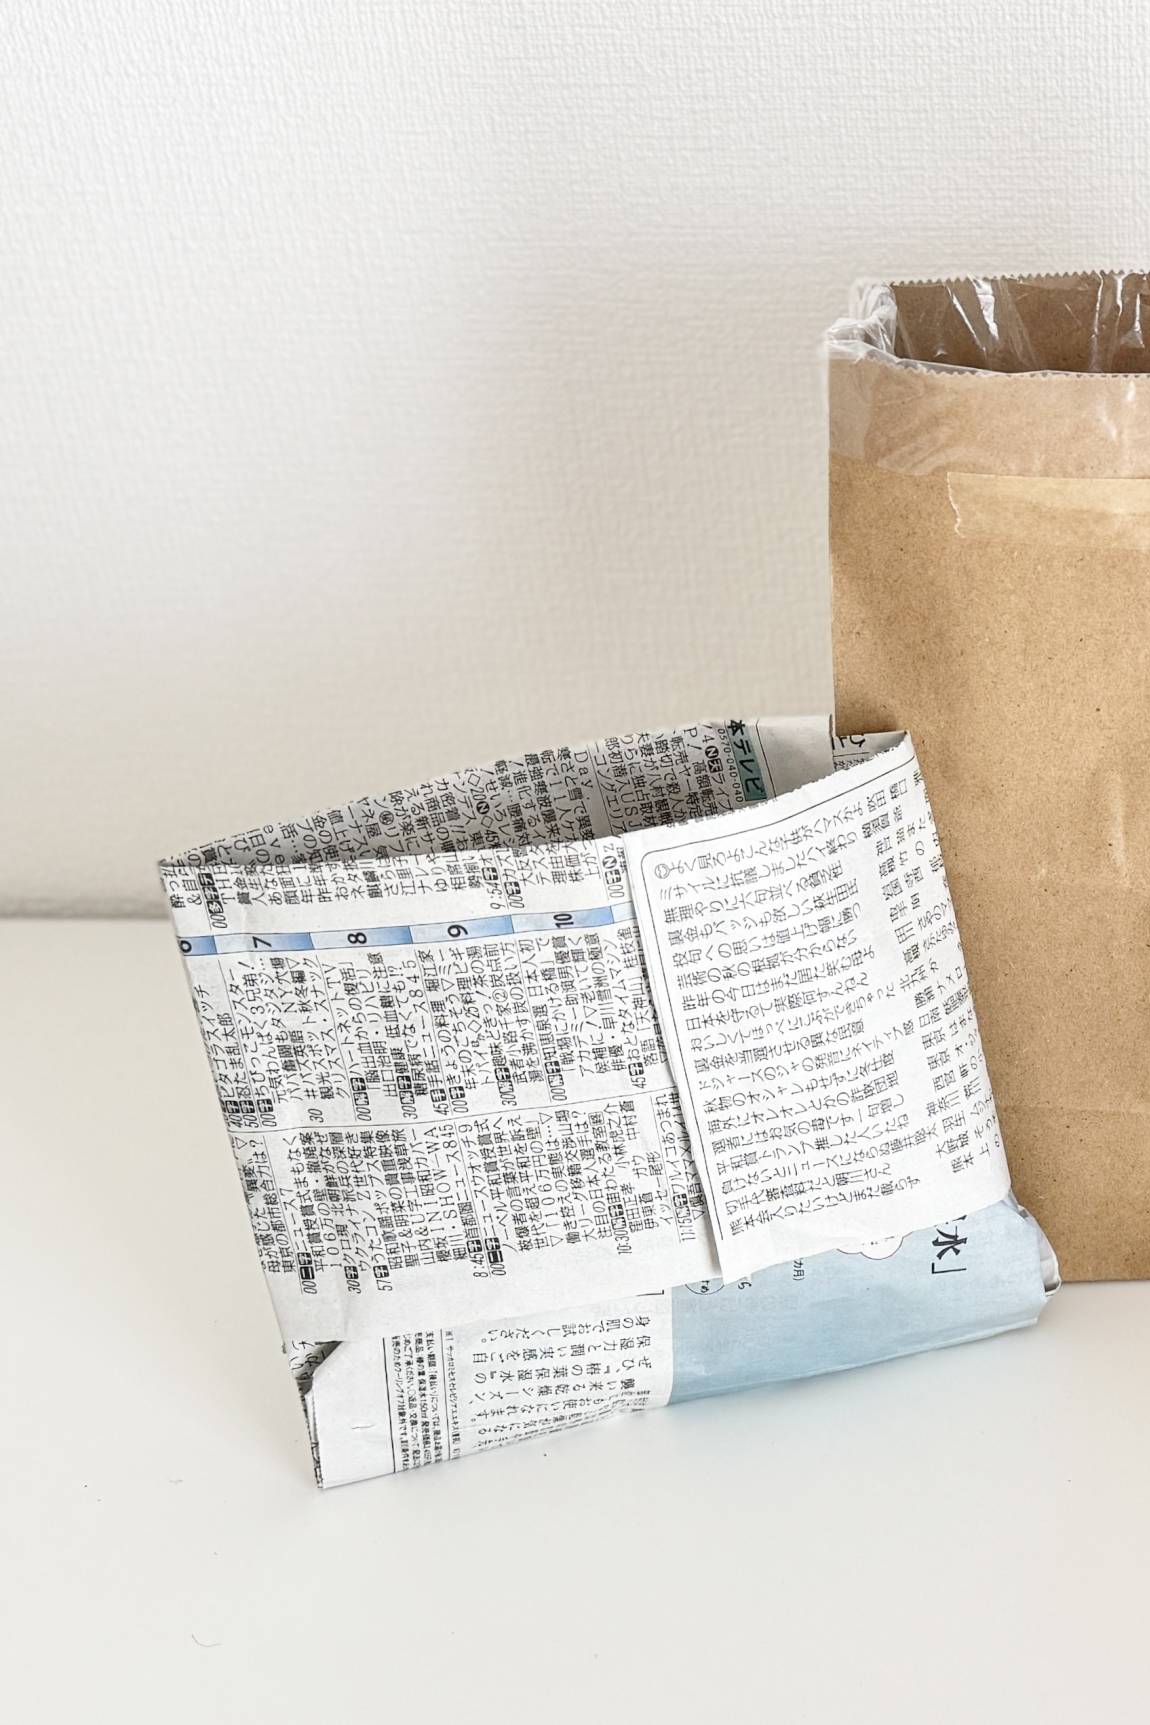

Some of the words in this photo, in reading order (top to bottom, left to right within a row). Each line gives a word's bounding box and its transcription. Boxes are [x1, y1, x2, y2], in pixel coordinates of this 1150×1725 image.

[691, 760, 717, 816] 高額転売
[552, 912, 574, 928] 10
[346, 931, 367, 945] 8
[446, 923, 468, 938] 9
[251, 934, 272, 948] 7
[519, 938, 542, 997] 日本人初
[313, 1130, 346, 1216] 北朝鮮がなぜ
